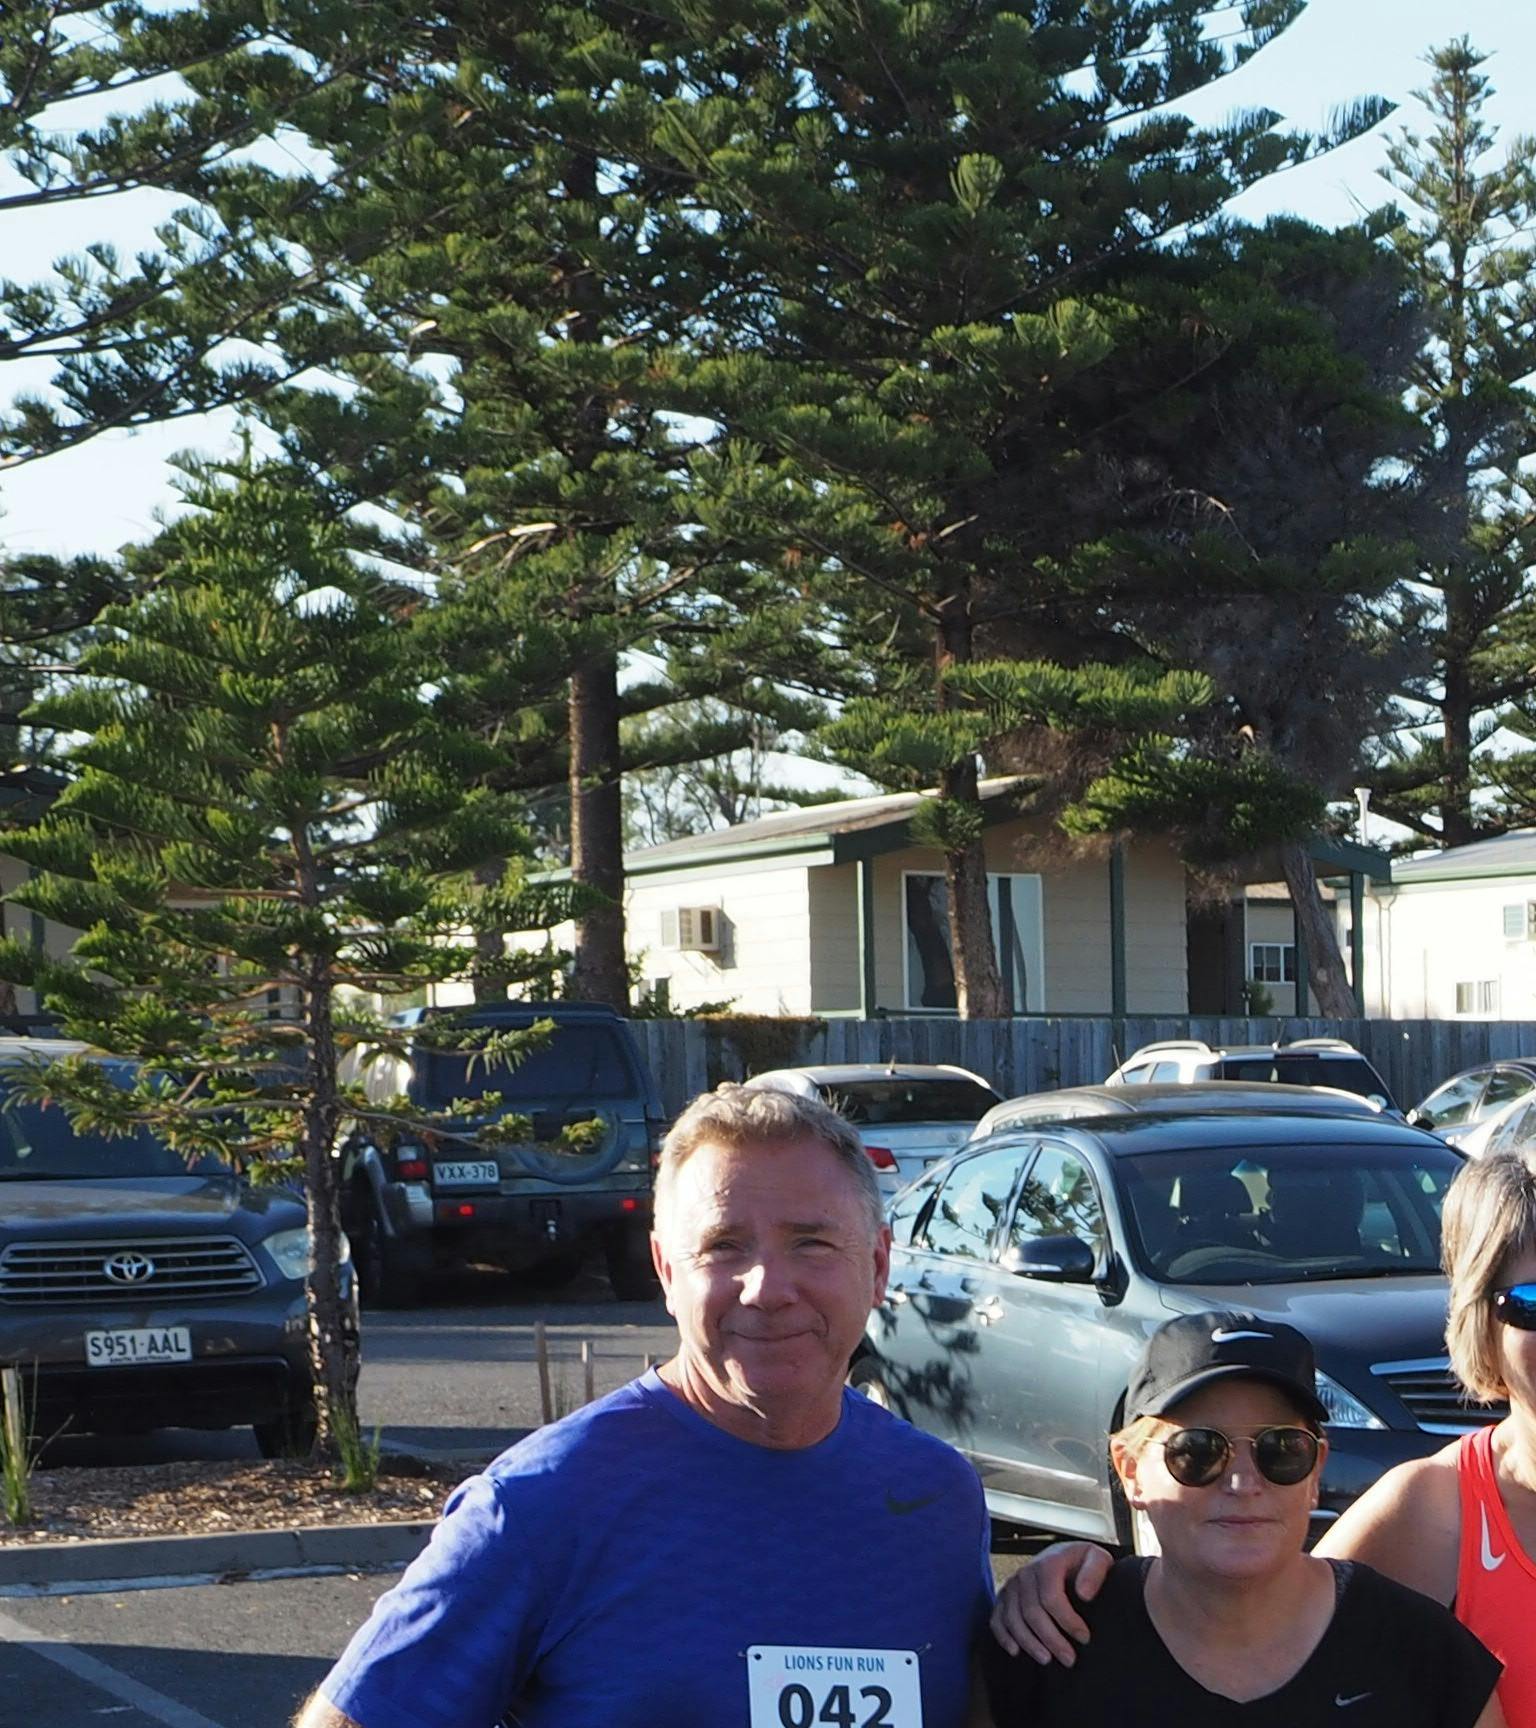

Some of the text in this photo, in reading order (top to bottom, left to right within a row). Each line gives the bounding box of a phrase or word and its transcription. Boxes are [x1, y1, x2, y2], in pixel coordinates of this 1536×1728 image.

[784, 1654, 885, 1673] LIONS FUN RUN
